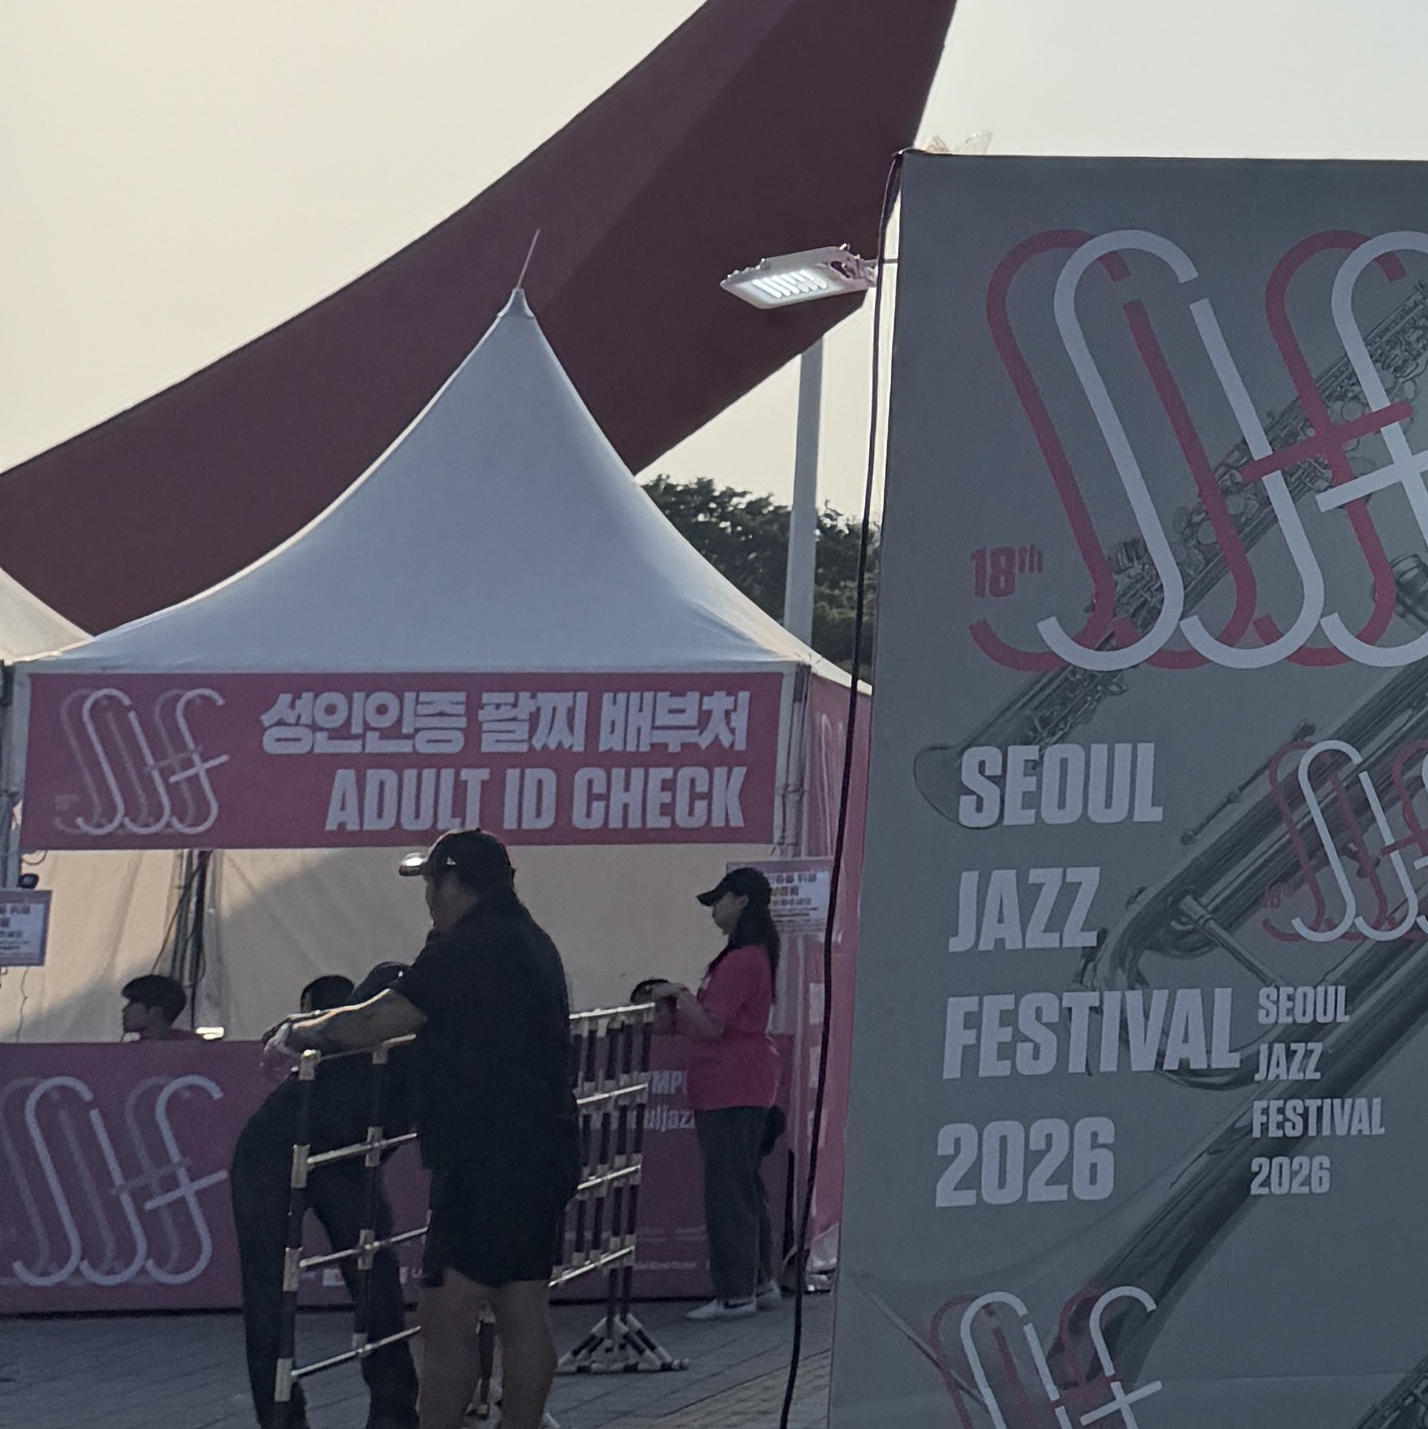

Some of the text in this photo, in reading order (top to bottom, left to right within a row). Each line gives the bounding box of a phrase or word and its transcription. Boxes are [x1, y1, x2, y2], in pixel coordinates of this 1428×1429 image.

[261, 690, 751, 755] 성인인증 팔찌 배부처
[324, 766, 748, 832] ADULT ID CHECK
[959, 742, 1163, 828] SEOUL
[948, 866, 1100, 953] JAZZ
[943, 987, 1240, 1080] FESTIVAL
[1258, 984, 1350, 1025] SEOUL
[1254, 1043, 1322, 1082] JAZZ
[1252, 1097, 1386, 1140] FESTIVAL
[935, 1117, 1115, 1208] 2026
[1250, 1155, 1331, 1196] 2026
